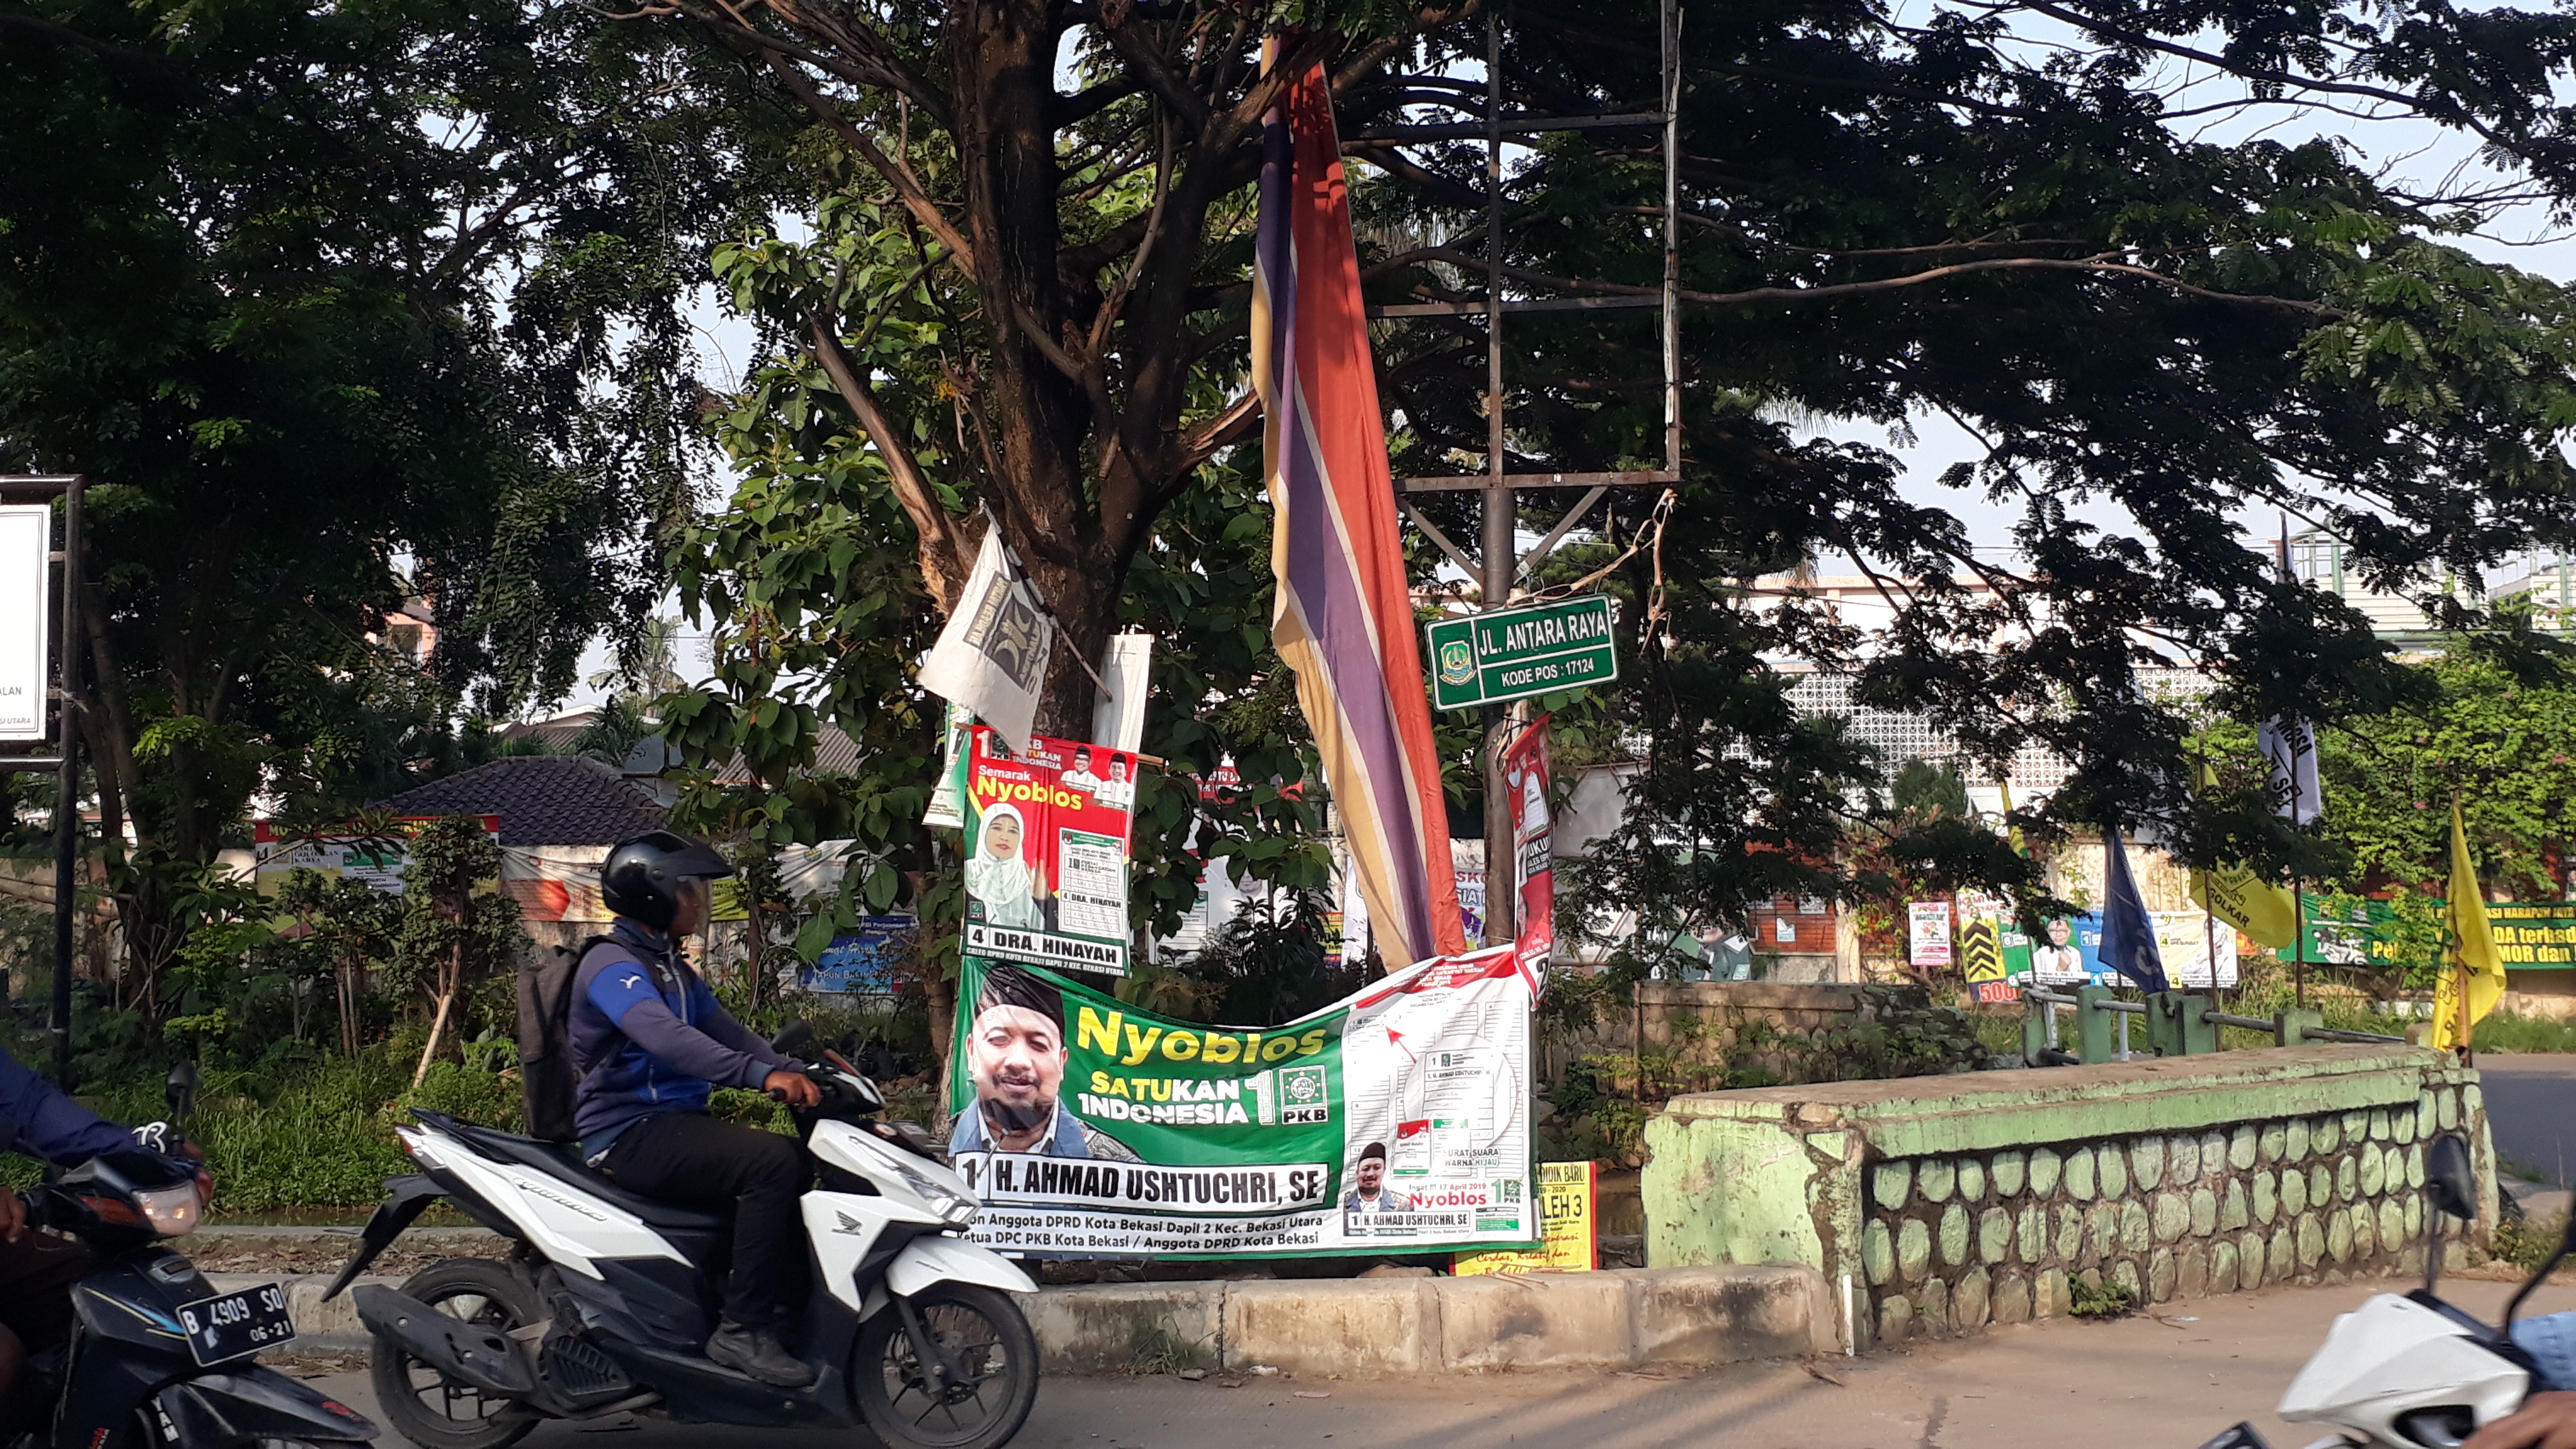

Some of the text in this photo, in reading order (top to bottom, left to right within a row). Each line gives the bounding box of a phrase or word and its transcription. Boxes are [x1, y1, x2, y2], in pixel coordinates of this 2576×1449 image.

[1480, 611, 1608, 656] JL. ANTARA RAYA
[1501, 668, 1533, 687] KODE
[1536, 665, 1558, 681] POS
[977, 730, 990, 758] 1
[978, 764, 1031, 781] Semarak
[977, 775, 1082, 811] Nyoblos
[972, 929, 1117, 964] 4 DRA. HINAYAH
[2537, 945, 2572, 962] dan
[2008, 975, 2017, 986] 6
[2172, 976, 2180, 986] 4
[1076, 1005, 1327, 1066] Nyoblos
[1090, 1071, 1239, 1103] SATUKAN
[1283, 1109, 1328, 1123] PKB
[1472, 1148, 1499, 1156] SUARA
[962, 1159, 1319, 1206] 1 H. AHMAD USHTUCHRI, SE
[1564, 1165, 1585, 1182] BARU
[1468, 1182, 1486, 1190] 2019
[1491, 1178, 1501, 1203] 1
[1410, 1191, 1487, 1209] Nyoblos
[1573, 1194, 1583, 1217] 3
[988, 1213, 1042, 1228] Anggota
[1046, 1216, 1081, 1227] DPRD
[1085, 1217, 1116, 1229] Kota
[1121, 1218, 1162, 1232] Bekasi
[1166, 1222, 1199, 1236] Dapil
[1204, 1224, 1211, 1233] 2
[1215, 1223, 1241, 1234] Kec.
[1246, 1219, 1286, 1232] Bekasi
[1289, 1216, 1322, 1228] Utara
[1352, 1217, 1359, 1226] 1
[1374, 1215, 1404, 1226] AHMAD
[1458, 1214, 1467, 1225] SE
[995, 1232, 1022, 1244] DPC
[1025, 1233, 1051, 1245] PKB
[1055, 1234, 1085, 1247] Kota
[1088, 1235, 1129, 1247] Bekasi
[1133, 1235, 1141, 1248] /
[1144, 1237, 1199, 1250] Anggota
[1204, 1237, 1240, 1249] DPRD
[1244, 1236, 1274, 1246] Kota
[1278, 1231, 1319, 1244] Bekasi
[1476, 1252, 1513, 1262] Cerdas,
[1552, 1247, 1570, 1258] dan
[182, 1310, 200, 1335] B
[210, 1297, 250, 1325] 4909
